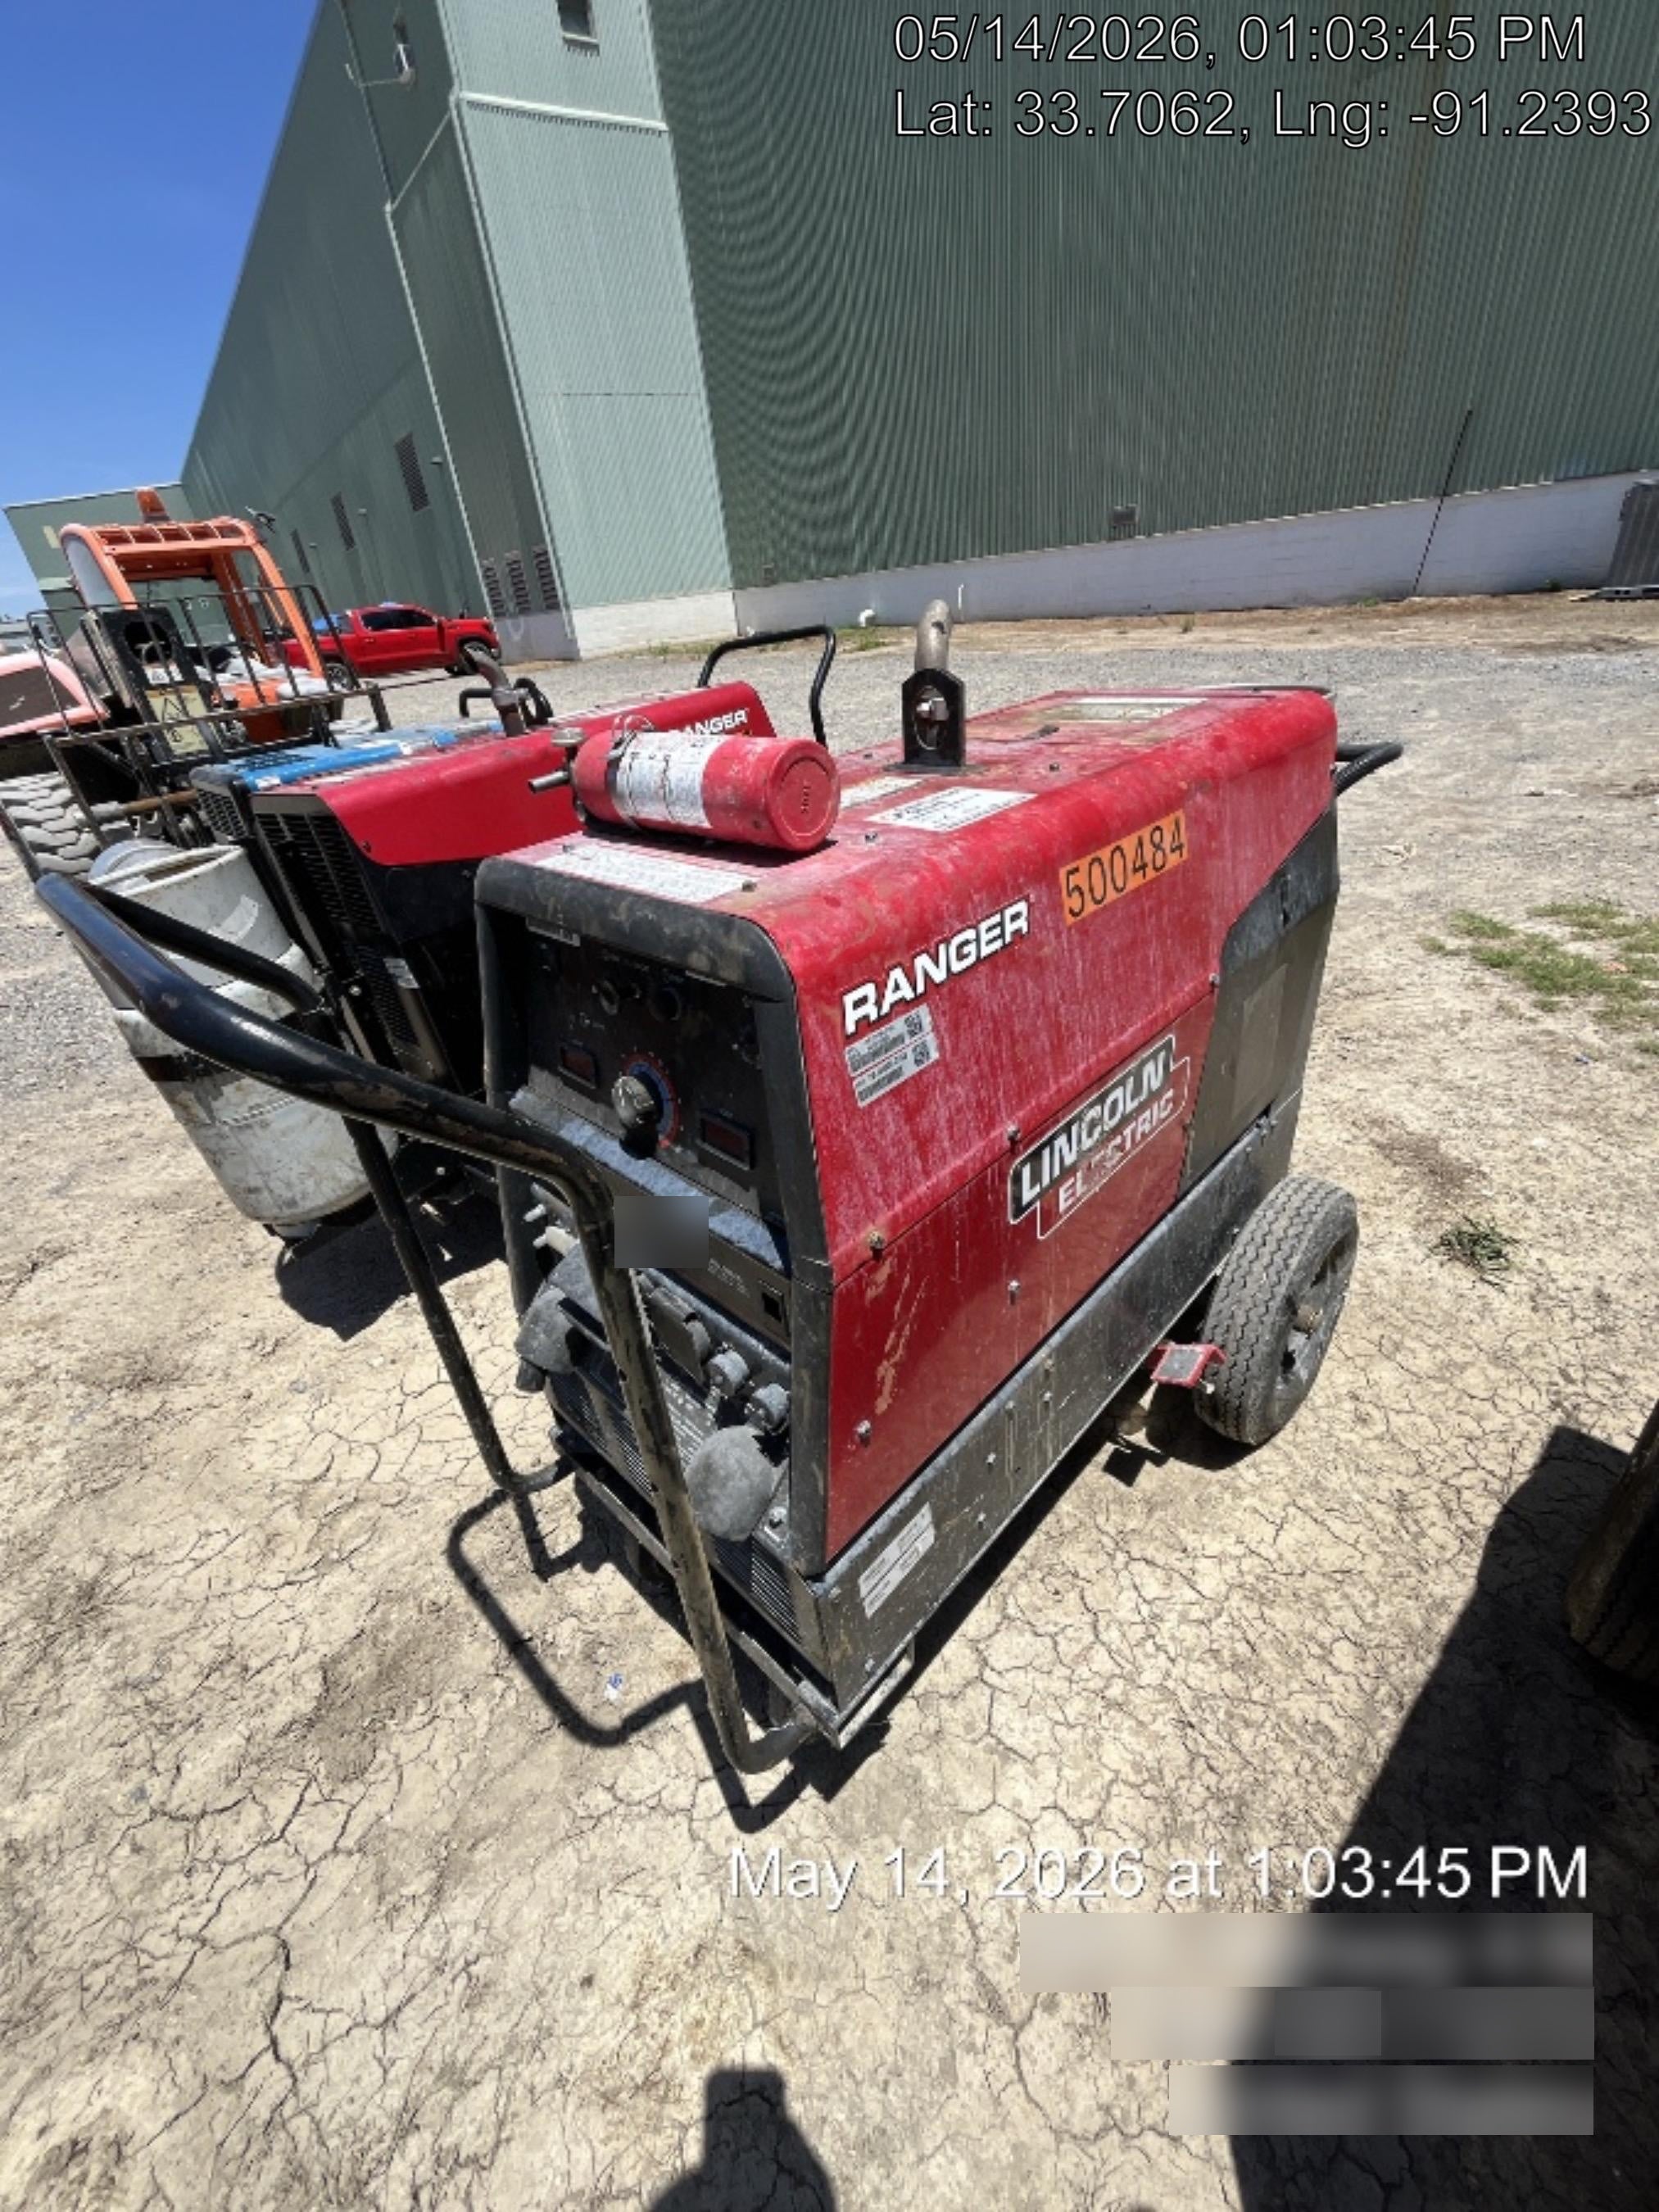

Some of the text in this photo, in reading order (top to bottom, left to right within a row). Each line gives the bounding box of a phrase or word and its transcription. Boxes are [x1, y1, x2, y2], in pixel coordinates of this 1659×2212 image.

[669, 709, 748, 736] ANGER
[1065, 816, 1185, 918] 500484
[842, 899, 1030, 1036] RANGER
[1021, 1049, 1167, 1207] LINCOLN
